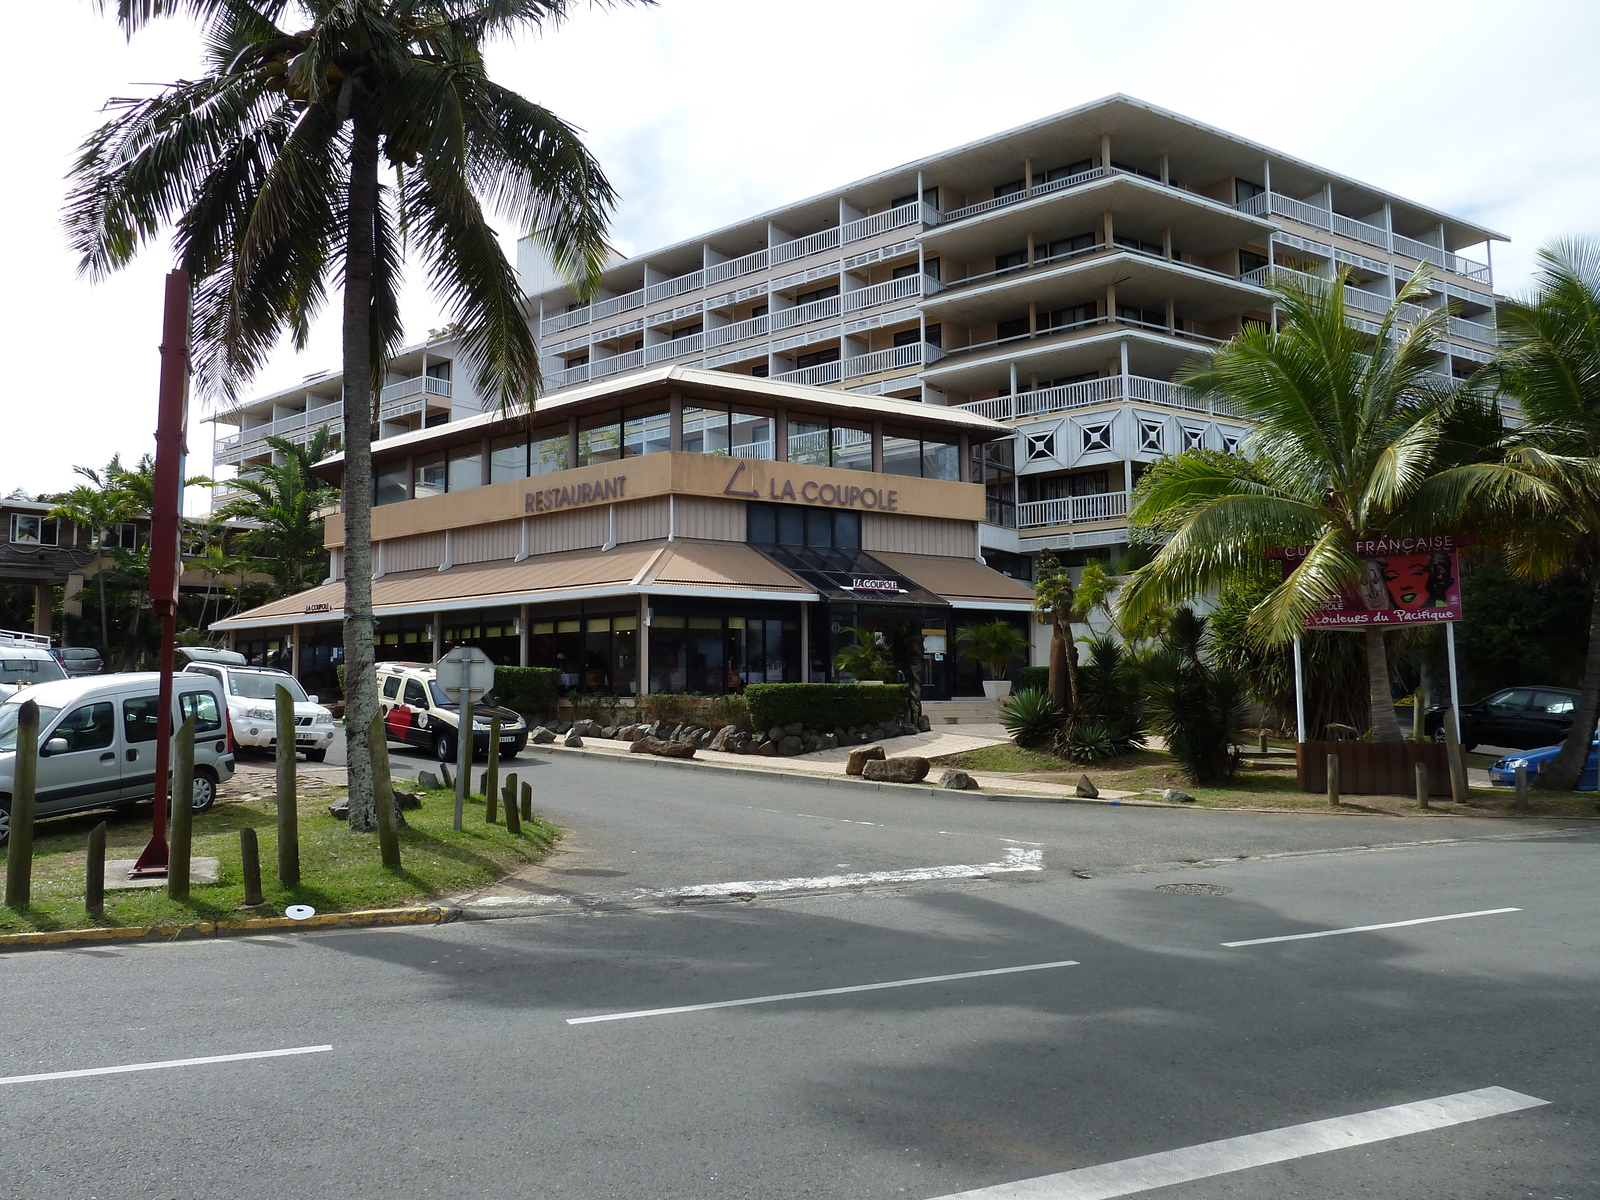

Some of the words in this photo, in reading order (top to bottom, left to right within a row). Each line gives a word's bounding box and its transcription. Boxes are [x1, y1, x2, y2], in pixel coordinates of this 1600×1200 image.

[525, 475, 626, 512] RESTAURANT
[770, 477, 796, 500] LA
[801, 481, 897, 510] COUPOLE
[1356, 535, 1453, 553] FRANÇAISE
[853, 578, 864, 588] LA
[864, 579, 897, 589] COUPOLE
[1373, 611, 1390, 622] du
[1393, 609, 1455, 622] Pacifique
